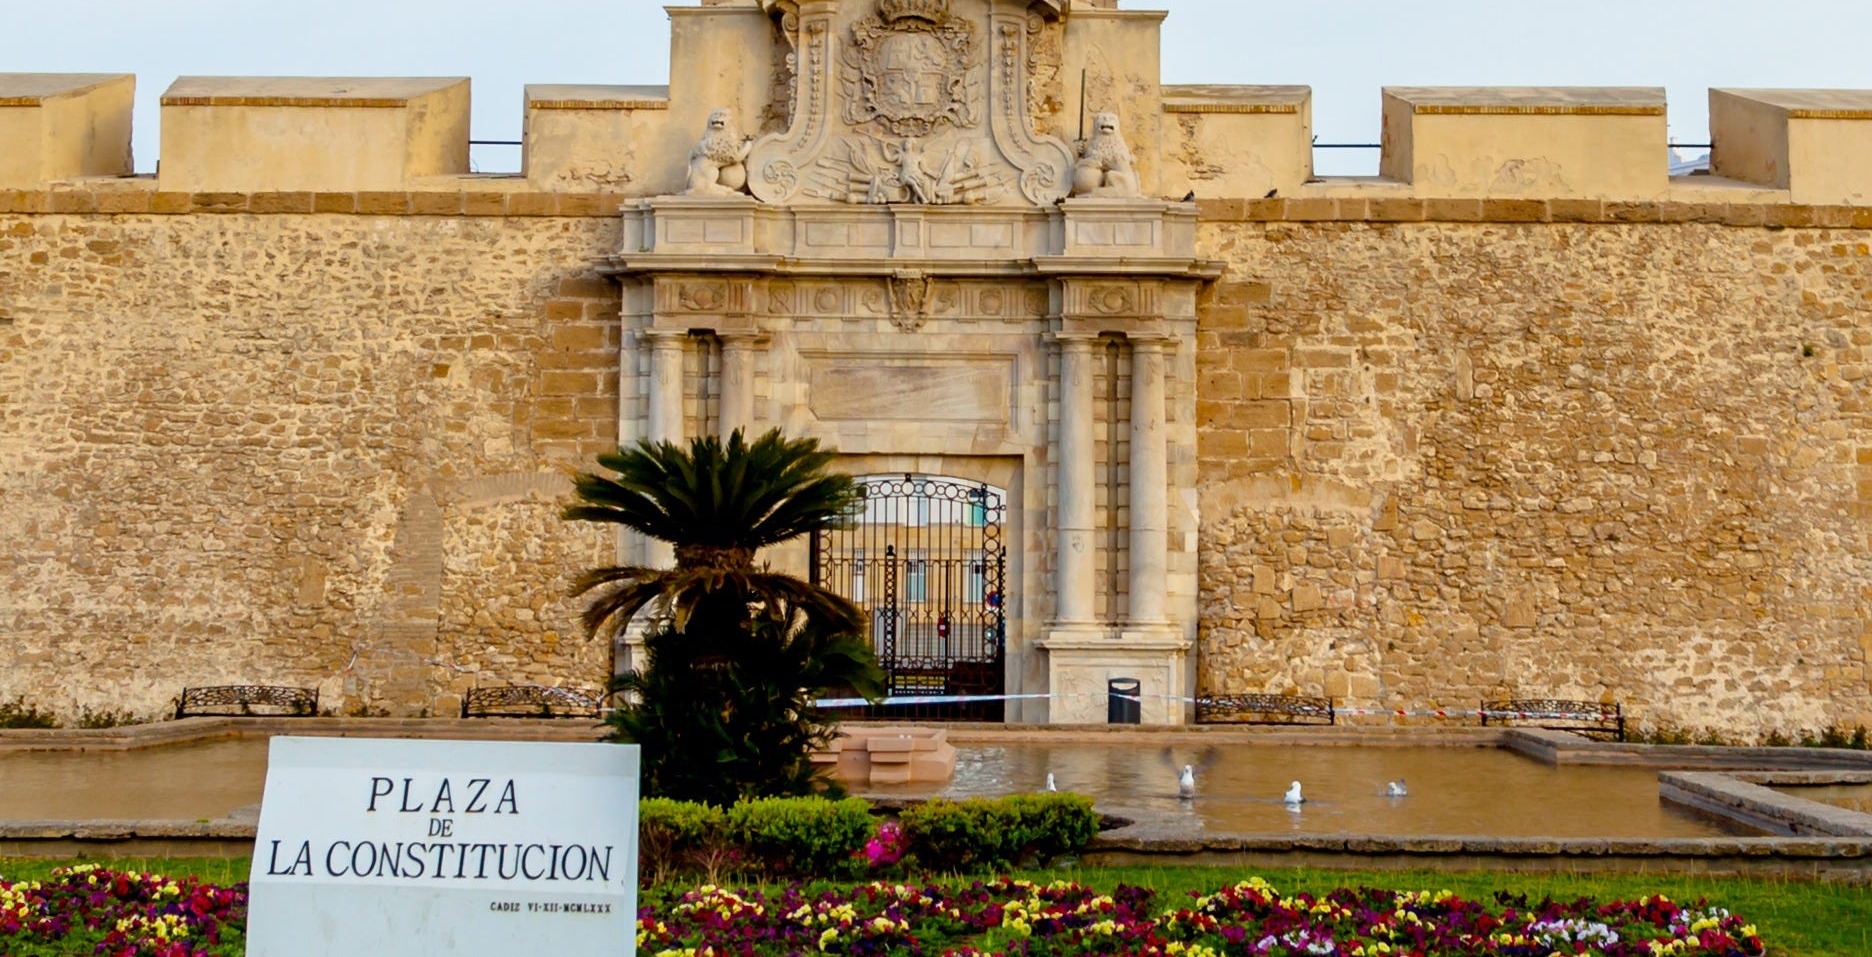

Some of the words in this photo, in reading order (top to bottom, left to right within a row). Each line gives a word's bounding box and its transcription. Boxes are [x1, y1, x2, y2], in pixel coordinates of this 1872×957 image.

[366, 777, 519, 815] PLAZA
[427, 817, 454, 838] DE
[266, 839, 314, 877] LA
[325, 840, 614, 882] CONSTITUCION
[489, 901, 521, 913] CADIZ
